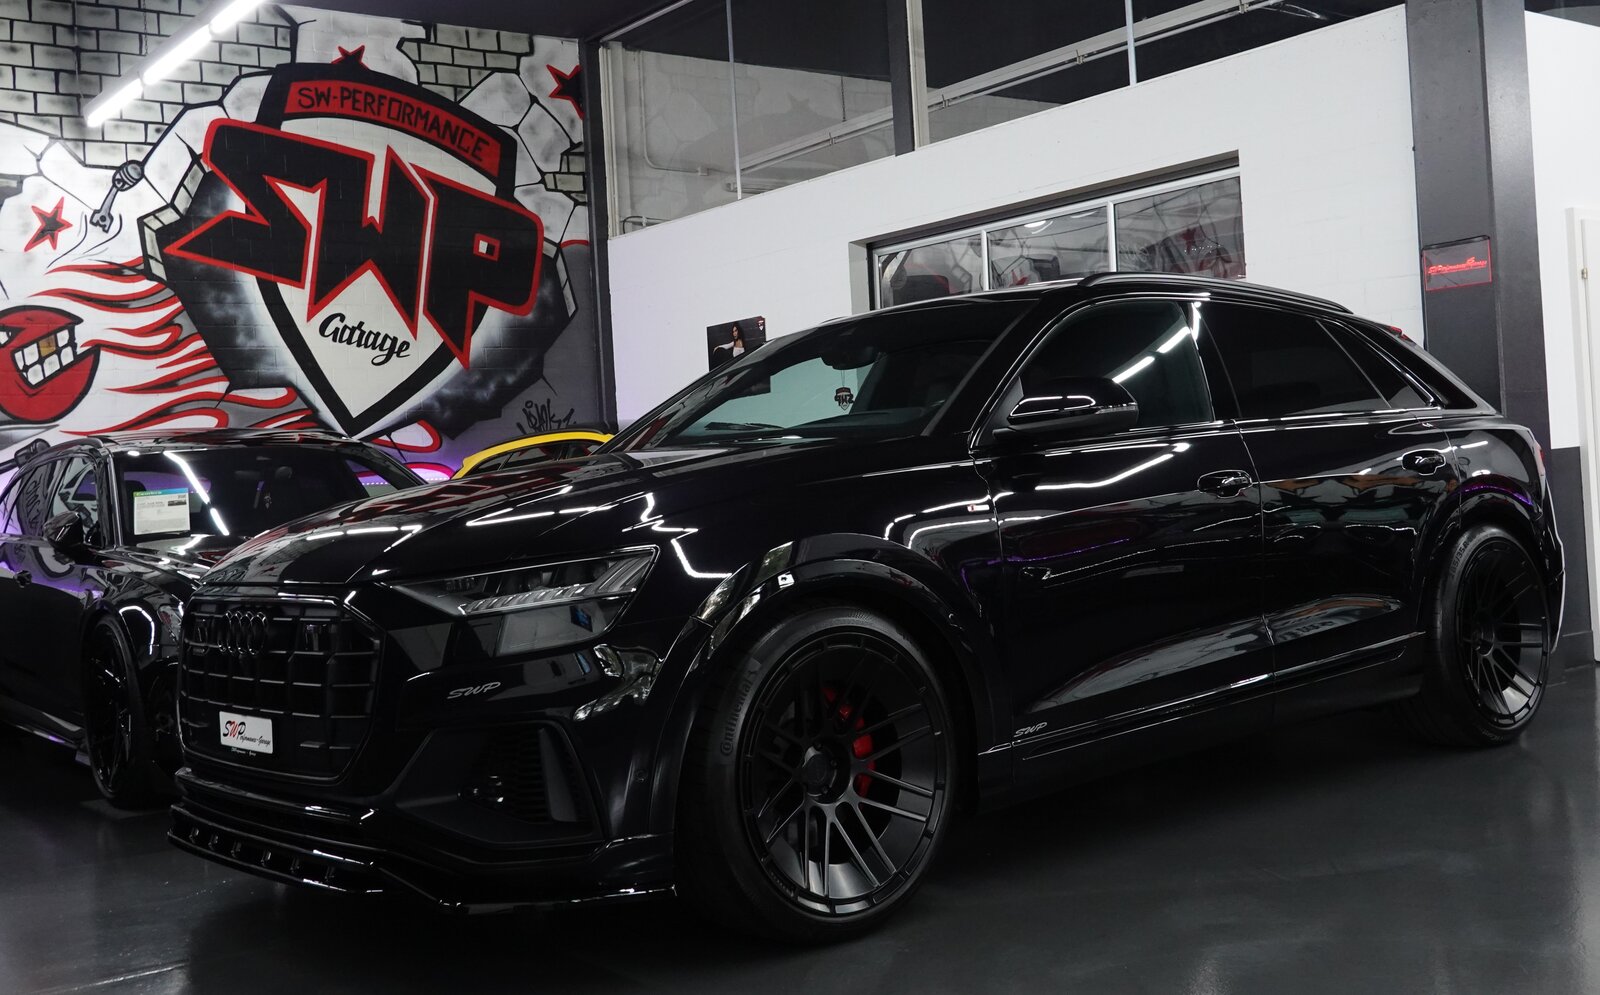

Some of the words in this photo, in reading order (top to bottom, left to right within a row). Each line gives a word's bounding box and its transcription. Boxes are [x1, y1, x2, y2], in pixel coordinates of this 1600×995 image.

[298, 86, 490, 161] SW-PERFORMANCE
[163, 118, 544, 370] SWP
[318, 312, 411, 366] Garage
[447, 681, 501, 699] SWP
[1013, 721, 1048, 738] SWP
